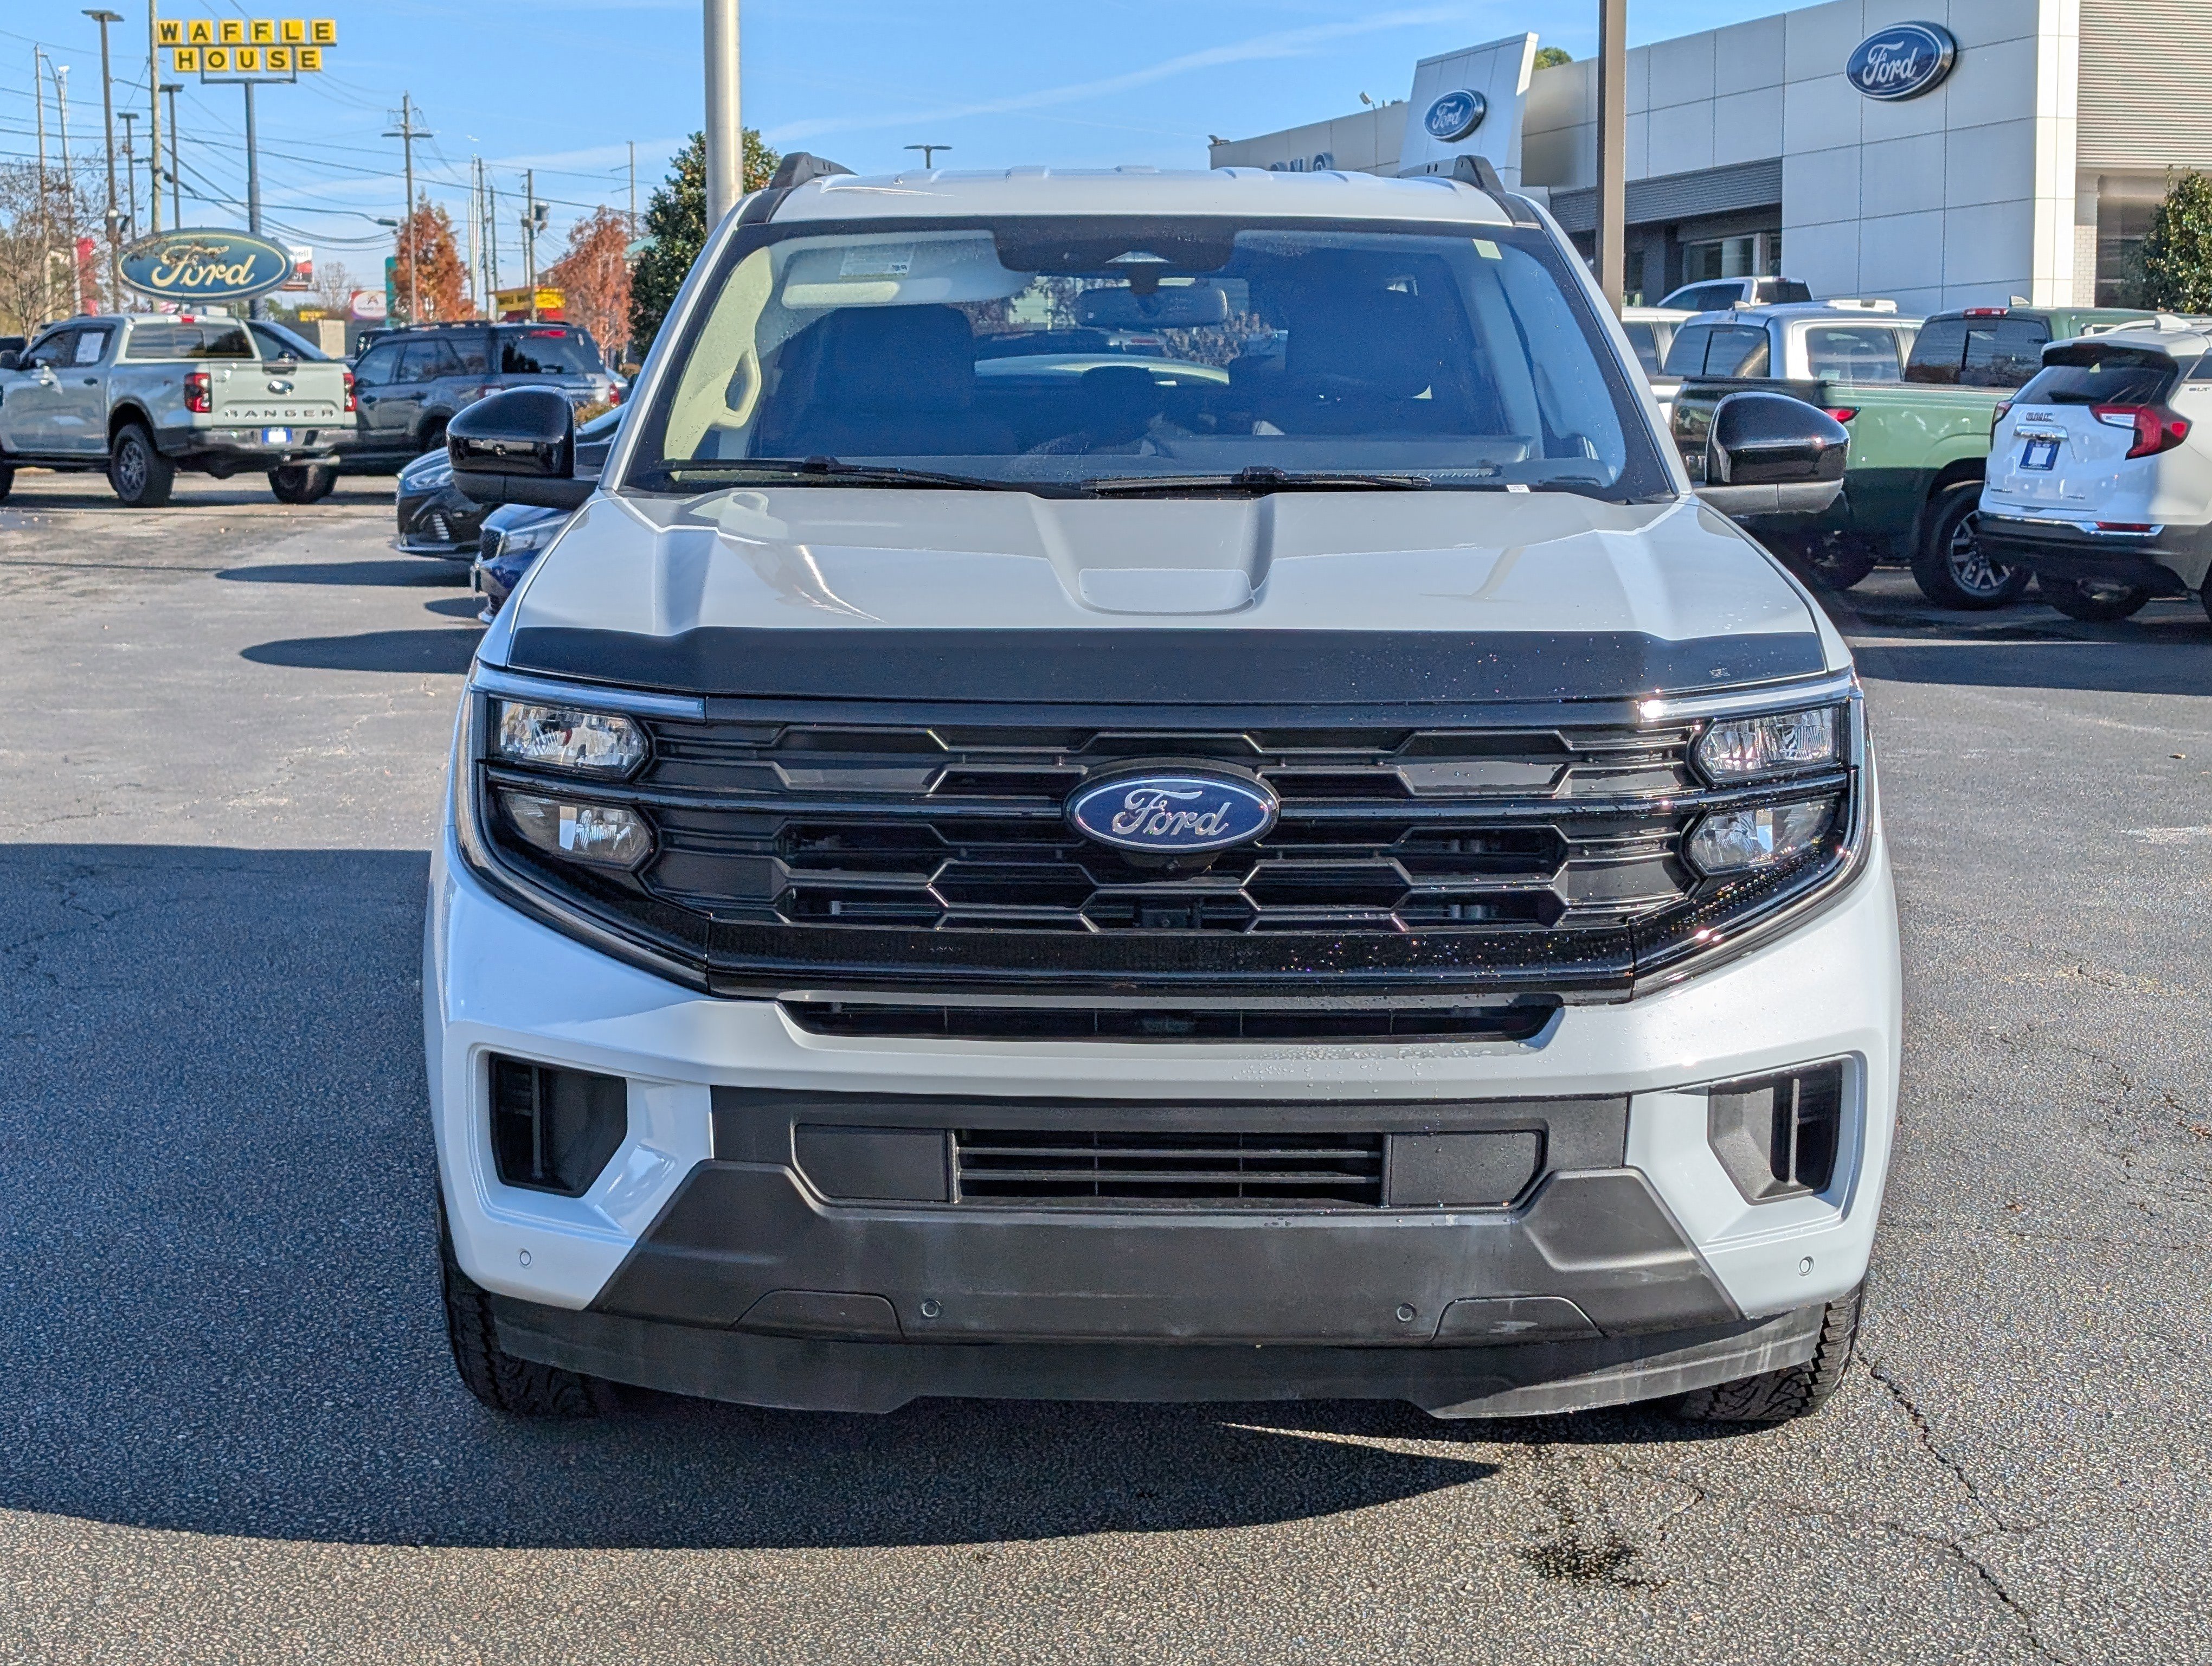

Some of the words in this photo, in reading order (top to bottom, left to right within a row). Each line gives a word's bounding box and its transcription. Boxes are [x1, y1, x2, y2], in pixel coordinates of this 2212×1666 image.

[160, 22, 331, 41] WAFFLE
[178, 50, 317, 69] HOUSE
[1862, 41, 1919, 86] Ford
[1432, 101, 1464, 130] Ford
[151, 245, 257, 288] Ford
[224, 409, 335, 419] RANGER
[2025, 412, 2055, 422] GMC
[1111, 788, 1233, 836] Ford
